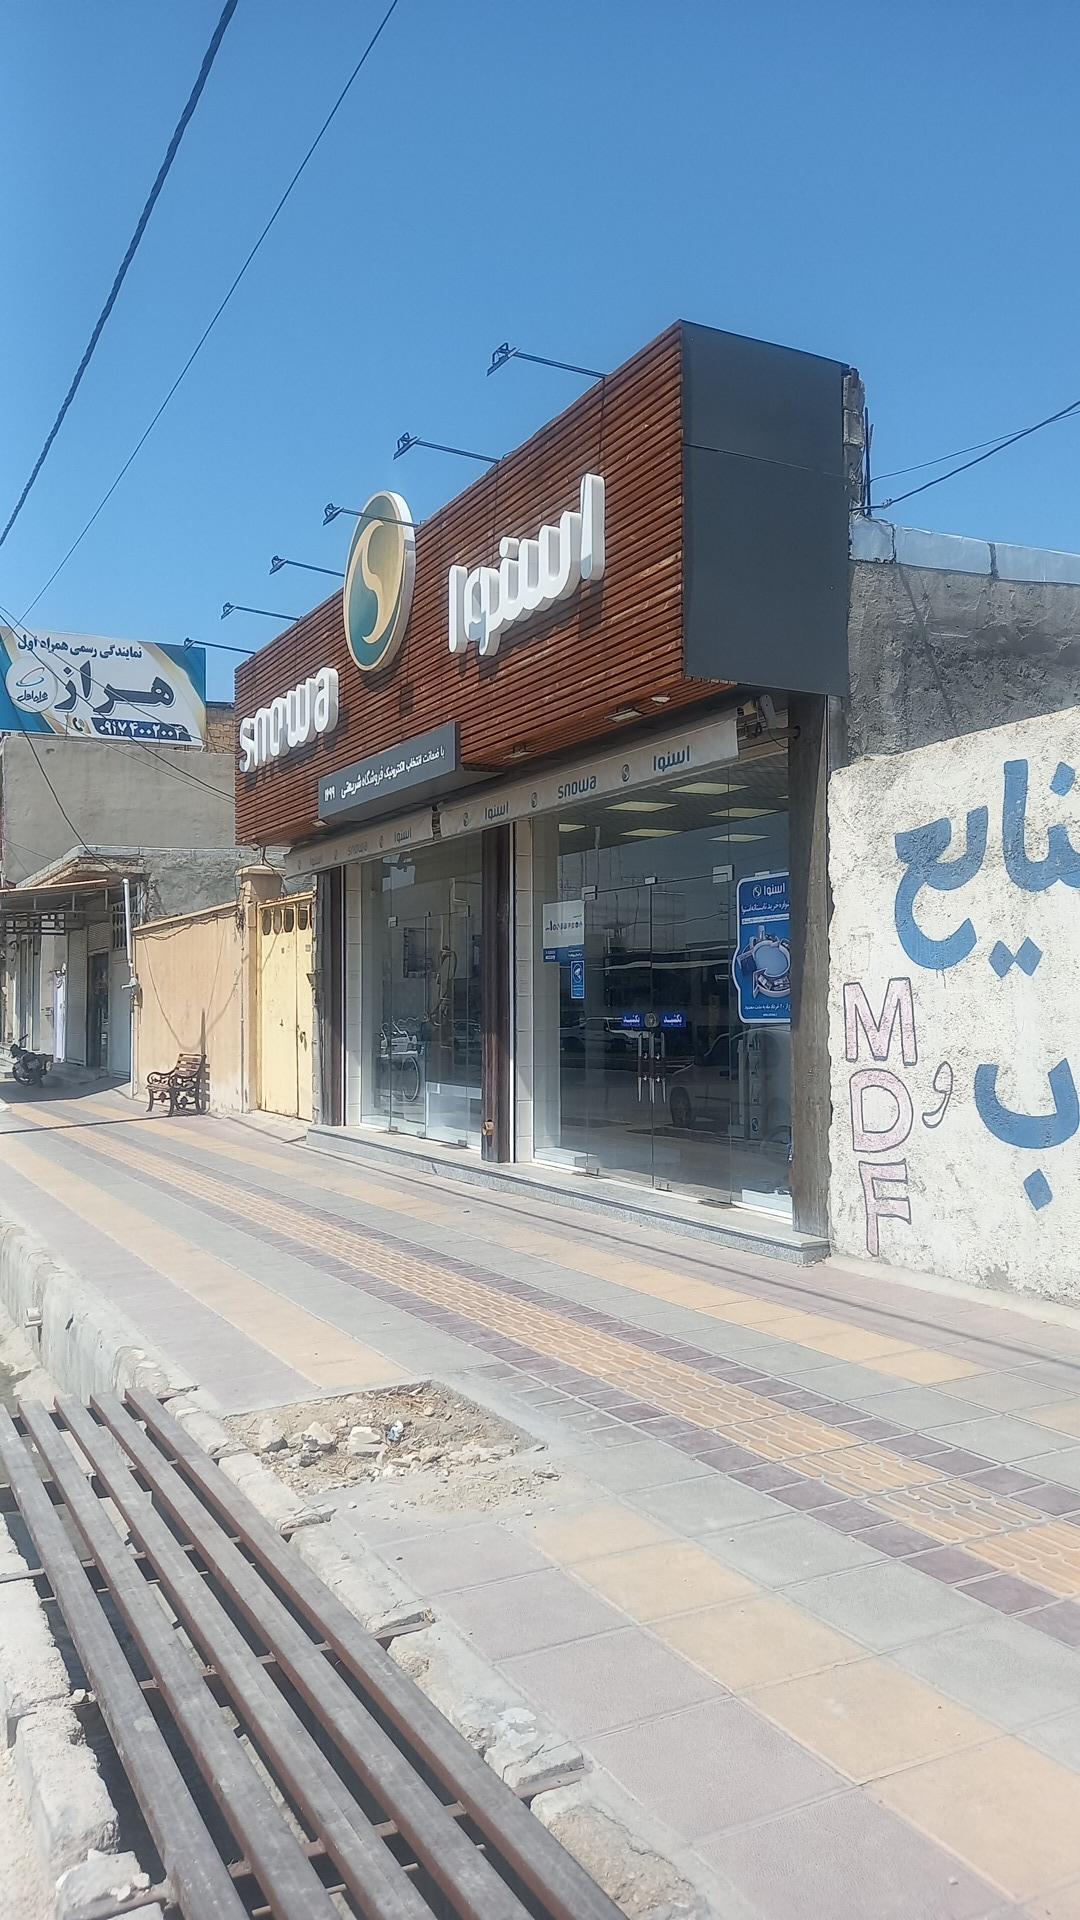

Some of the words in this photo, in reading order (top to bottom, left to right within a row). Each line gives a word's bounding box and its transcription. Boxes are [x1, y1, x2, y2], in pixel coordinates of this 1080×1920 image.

[449, 473, 605, 656] اسنوا
[18, 635, 38, 651] اول
[40, 637, 69, 653] همراه
[70, 647, 98, 658] رسمی
[99, 645, 142, 661] نمایندگی
[54, 660, 175, 713] هراز
[239, 667, 339, 773] snowa
[423, 748, 440, 763] ضمانت
[440, 745, 445, 758] با
[653, 745, 690, 771] اسنوا
[384, 761, 406, 779] الکترونیک
[405, 754, 422, 772] انتخاب
[362, 766, 384, 787] فروشگاه
[557, 775, 597, 800] snowa
[484, 801, 509, 821] اسنوا
[895, 759, 1080, 978] نایع
[763, 882, 786, 897] اسنوا
[843, 977, 917, 1257] MDF
